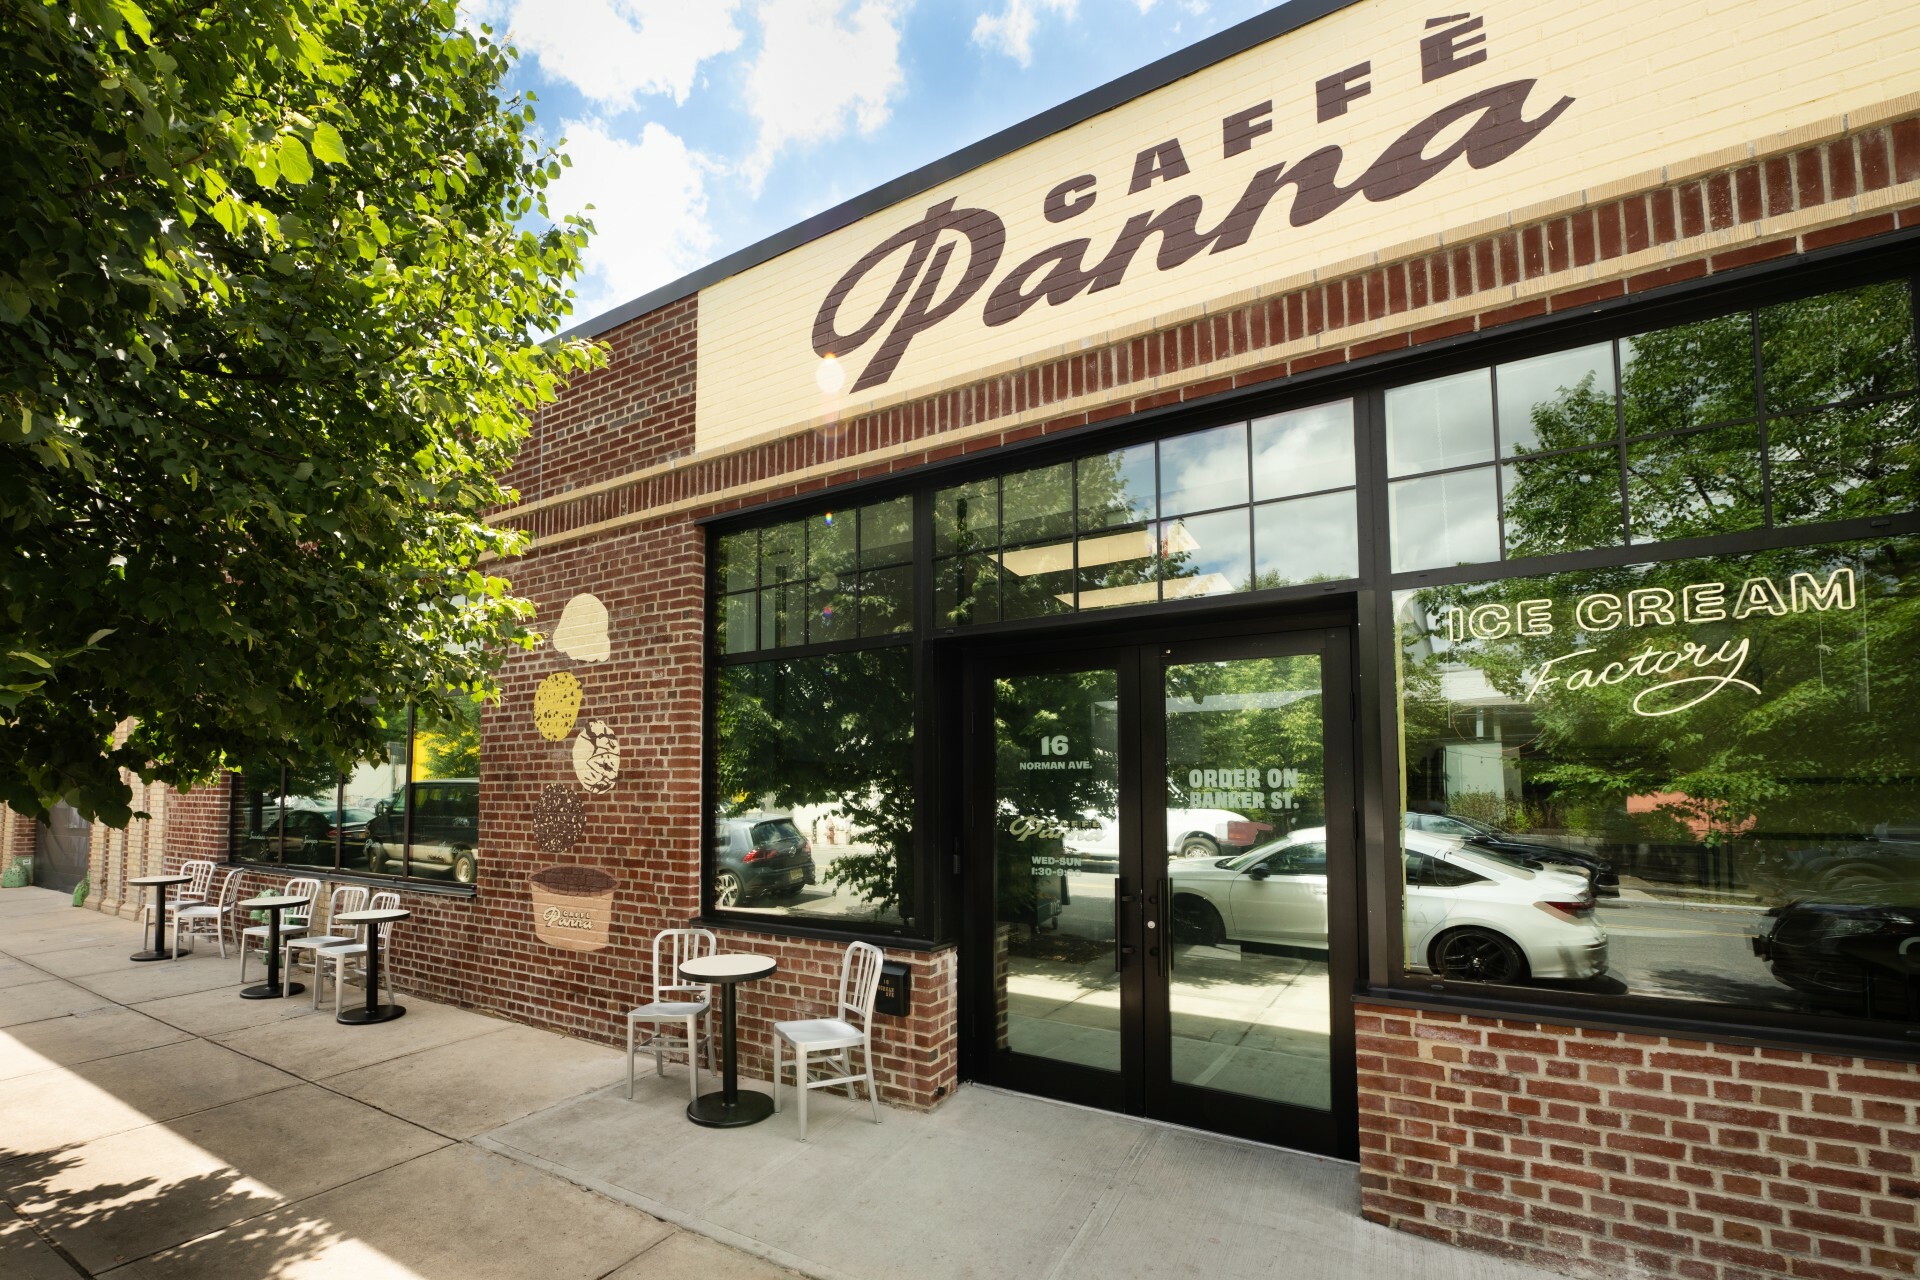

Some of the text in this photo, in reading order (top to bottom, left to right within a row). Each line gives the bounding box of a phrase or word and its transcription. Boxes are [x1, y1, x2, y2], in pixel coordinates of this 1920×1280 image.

[1044, 12, 1487, 222] CAFFÈ
[812, 79, 1576, 393] Panna
[1448, 568, 1857, 642] ICE CREAM
[1525, 638, 1762, 717] Factory
[1041, 735, 1069, 755] 16
[1020, 761, 1093, 770] NORMAN AVE.
[1189, 768, 1299, 789] ORDER ON
[1190, 791, 1300, 810] BANKER ST.
[1031, 856, 1082, 867] WED-SUN
[543, 906, 593, 930] Panna
